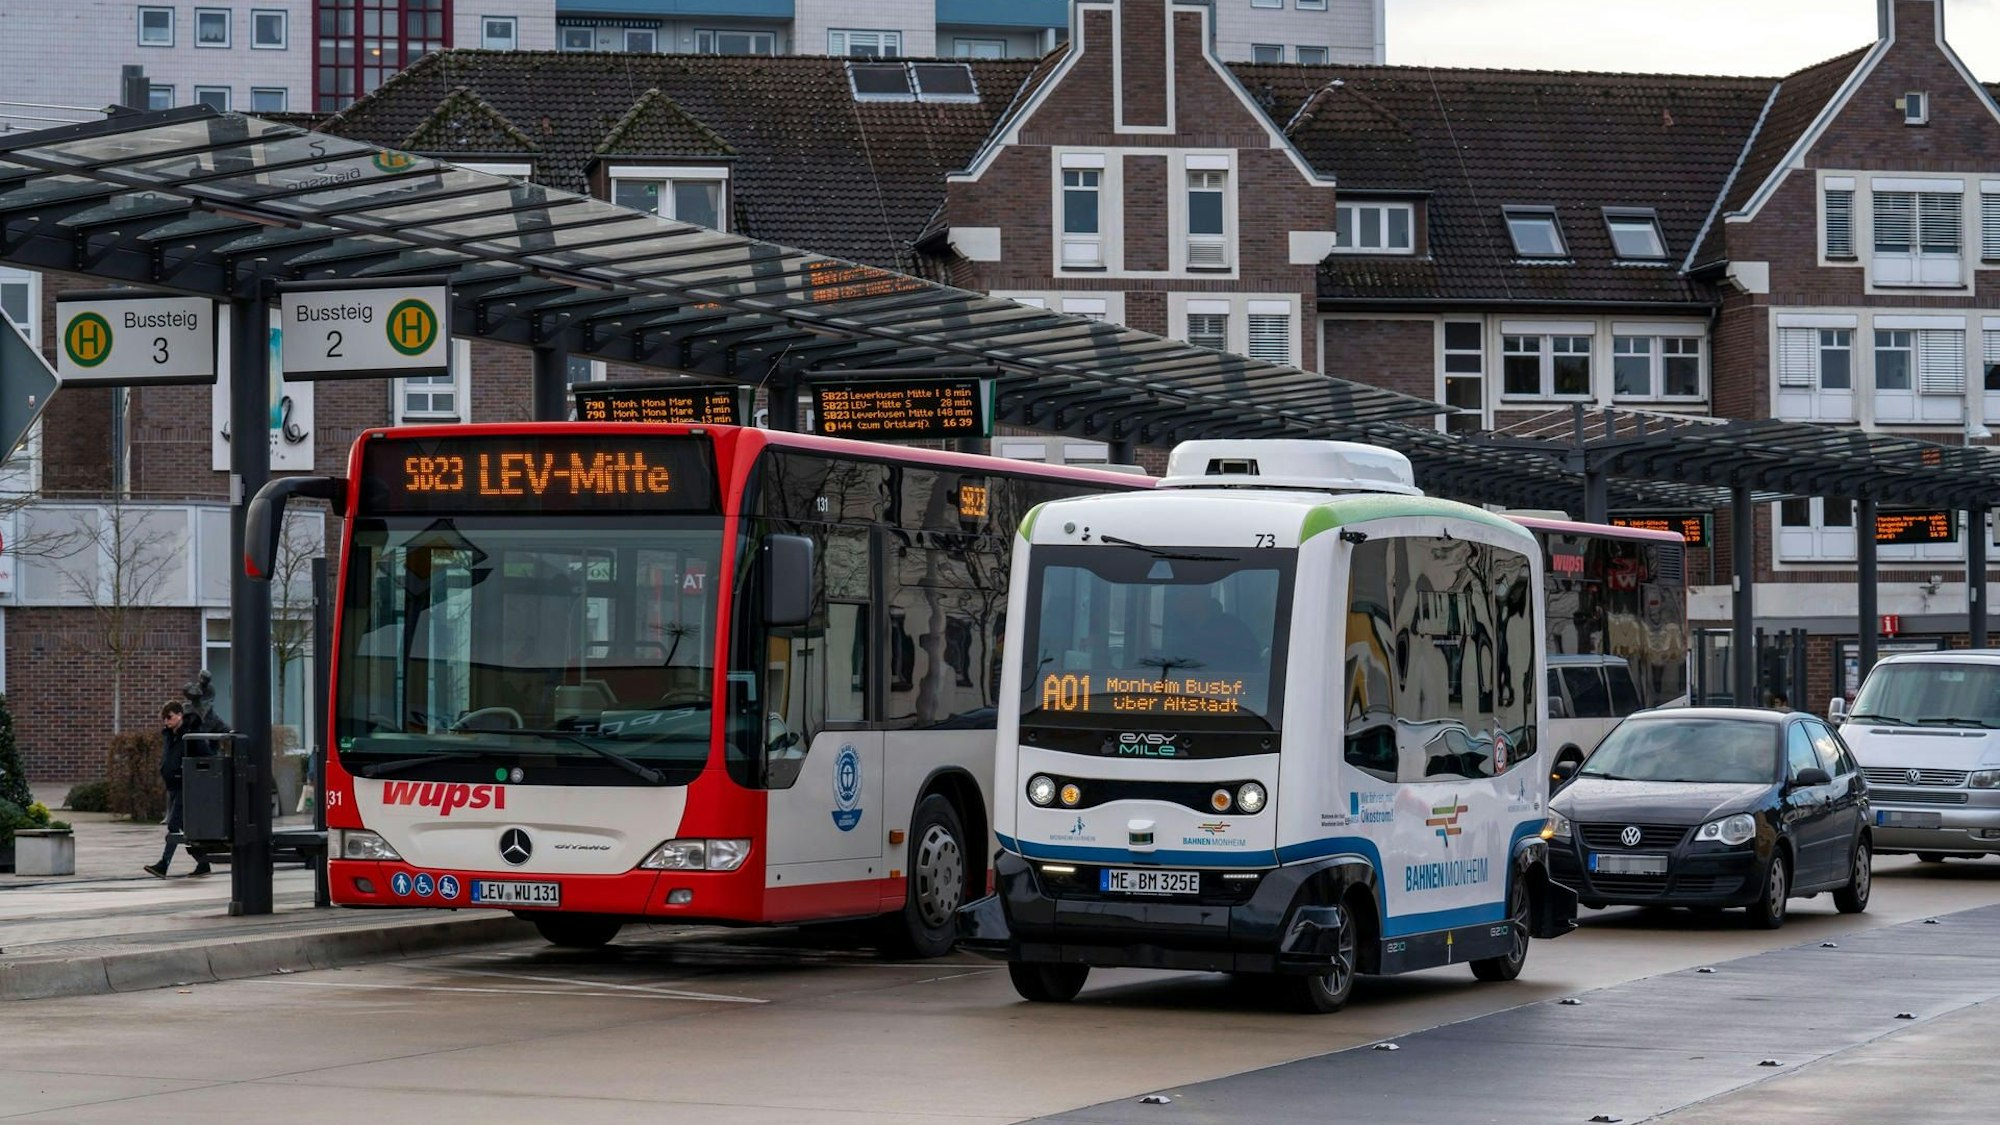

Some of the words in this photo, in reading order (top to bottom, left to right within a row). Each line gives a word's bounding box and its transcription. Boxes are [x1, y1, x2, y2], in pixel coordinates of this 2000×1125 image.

[124, 310, 198, 331] Bussteig
[297, 303, 373, 324] Bussteig
[152, 337, 170, 364] 3
[326, 331, 343, 358] 2
[585, 401, 605, 410] 790
[612, 400, 638, 409] Monh.
[641, 399, 666, 408] Mona
[669, 398, 693, 407] Mare
[705, 396, 710, 405] 1
[712, 396, 730, 404] min
[821, 391, 848, 401] SB23
[850, 390, 904, 400] Leverkusen
[907, 389, 932, 398] Mitte
[944, 389, 952, 397] 8
[953, 388, 971, 396] min
[586, 410, 606, 419] 790
[613, 410, 639, 418] Monh.
[643, 409, 667, 418] Mona
[670, 408, 694, 416] Mare
[705, 406, 711, 414] 6
[713, 406, 731, 414] min
[822, 401, 849, 410] SB23
[877, 400, 901, 408] Mitte
[905, 399, 912, 408] S
[940, 399, 953, 407] 28
[954, 398, 972, 406] min
[701, 416, 713, 424] 13
[714, 415, 732, 424] min
[823, 411, 850, 420] SB23
[851, 410, 905, 419] Leverkusen
[909, 409, 934, 418] Mitte
[955, 408, 973, 416] min
[857, 421, 880, 430] (zum
[884, 420, 929, 430] Ortstarif)
[943, 420, 957, 428] 16
[959, 419, 973, 427] 39
[405, 456, 465, 491] SB23
[479, 452, 670, 496] LEV-Mitte
[816, 497, 829, 512] 131
[1255, 533, 1276, 549] 73
[1043, 673, 1090, 712] A01
[1106, 677, 1180, 694] Monheim
[1185, 679, 1247, 695] Busbf.
[1113, 696, 1158, 711] über
[1163, 696, 1239, 713] Altstadt
[383, 774, 505, 816] wupsi
[1111, 872, 1128, 889] ME
[1139, 873, 1157, 890] BM
[1405, 863, 1444, 892] BAHNEN
[1446, 857, 1488, 887] MONHEIM
[480, 883, 505, 899] LEV
[514, 884, 533, 900] WU
[534, 885, 557, 902] 131
